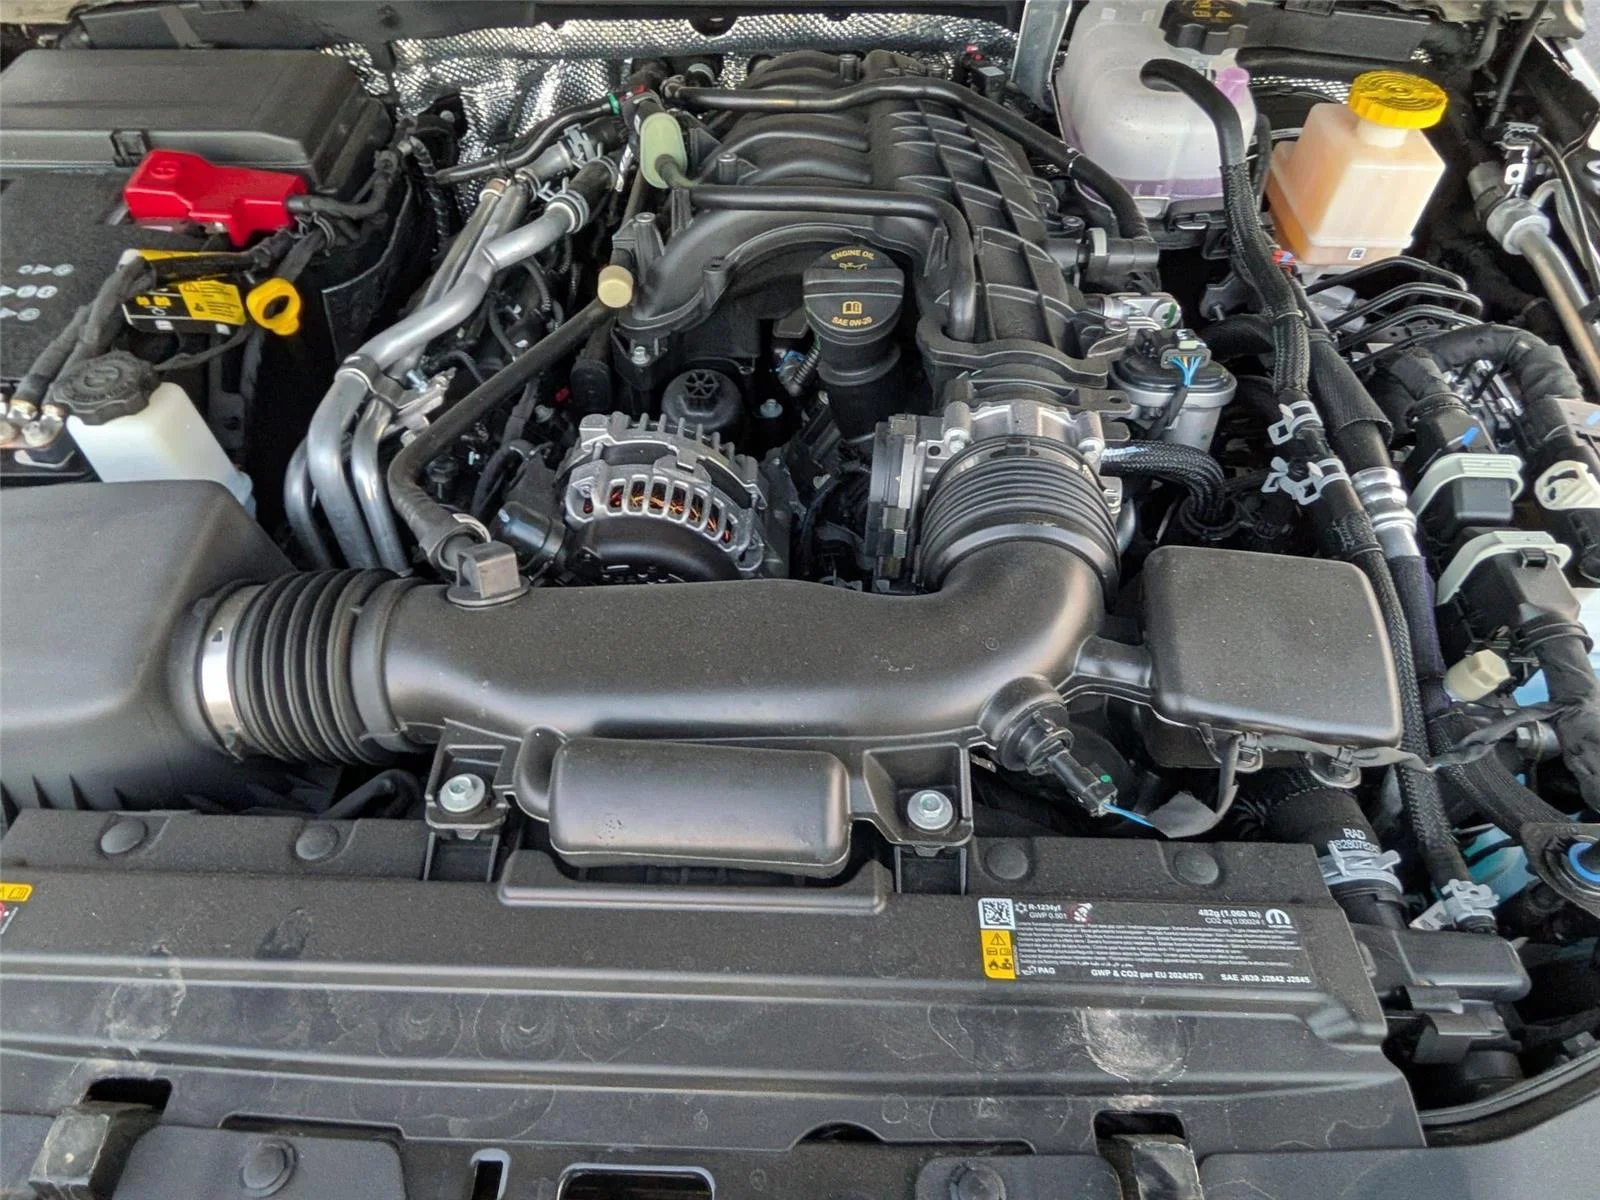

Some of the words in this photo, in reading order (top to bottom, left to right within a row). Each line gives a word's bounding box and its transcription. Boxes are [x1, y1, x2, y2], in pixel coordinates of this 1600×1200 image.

[831, 249, 861, 260] ENGINE
[862, 250, 874, 260] OIL
[832, 316, 847, 326] SAE
[849, 316, 872, 326] 0W-20
[1343, 828, 1366, 839] RAD
[1028, 903, 1062, 912] R-1234yf
[1029, 911, 1048, 919] GWP
[1091, 968, 1111, 976] GWP
[1113, 969, 1120, 977] &
[1120, 969, 1139, 978] CO2
[1140, 971, 1154, 979] per
[1154, 971, 1167, 979] EU
[1168, 971, 1204, 980] 2024/573
[1220, 973, 1239, 981] SAE
[1240, 974, 1260, 982] J639
